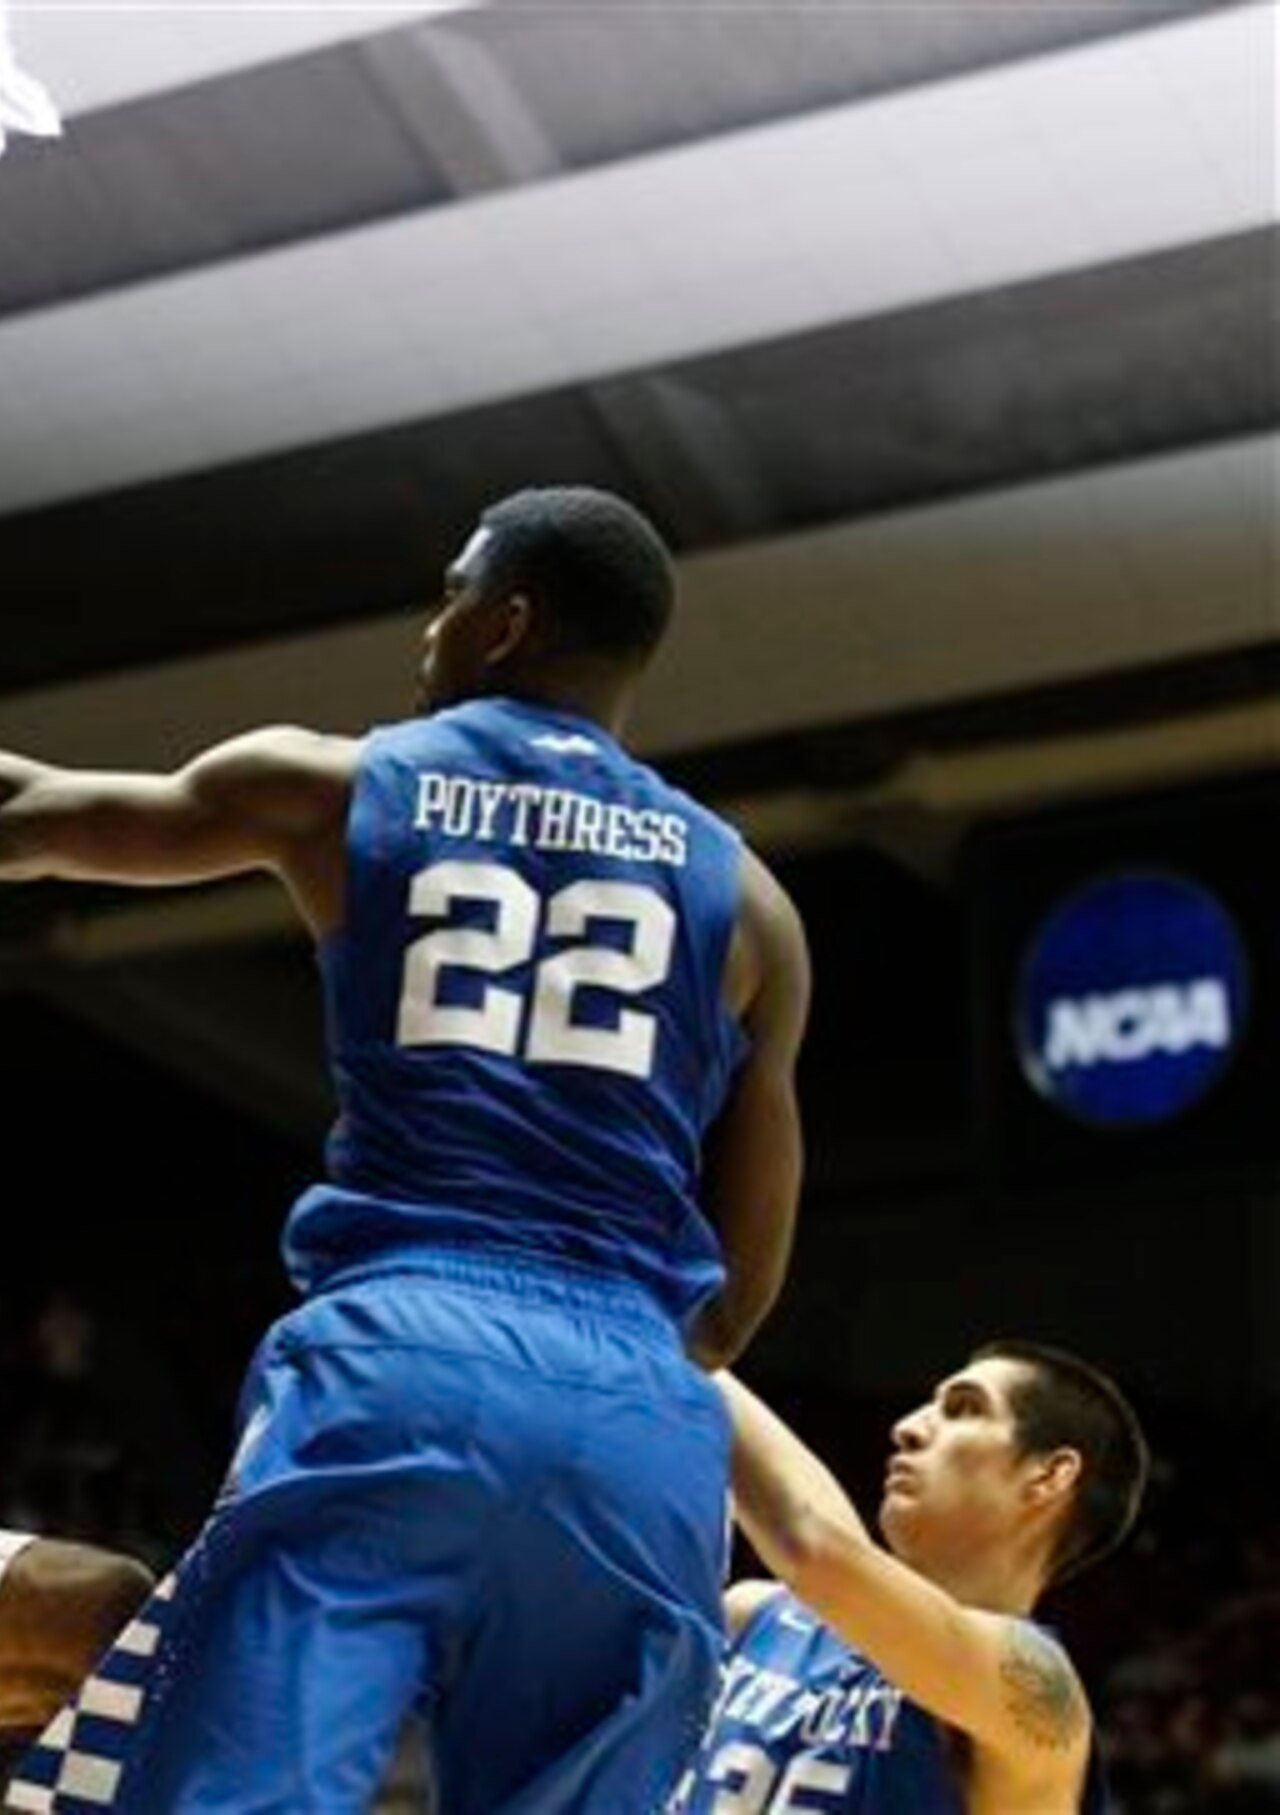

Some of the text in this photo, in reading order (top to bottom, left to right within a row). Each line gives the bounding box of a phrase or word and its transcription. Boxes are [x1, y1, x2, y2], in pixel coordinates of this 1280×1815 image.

[413, 773, 689, 866] POYTHRESS
[396, 859, 677, 1080] 22
[1044, 978, 1229, 1068] NCAA
